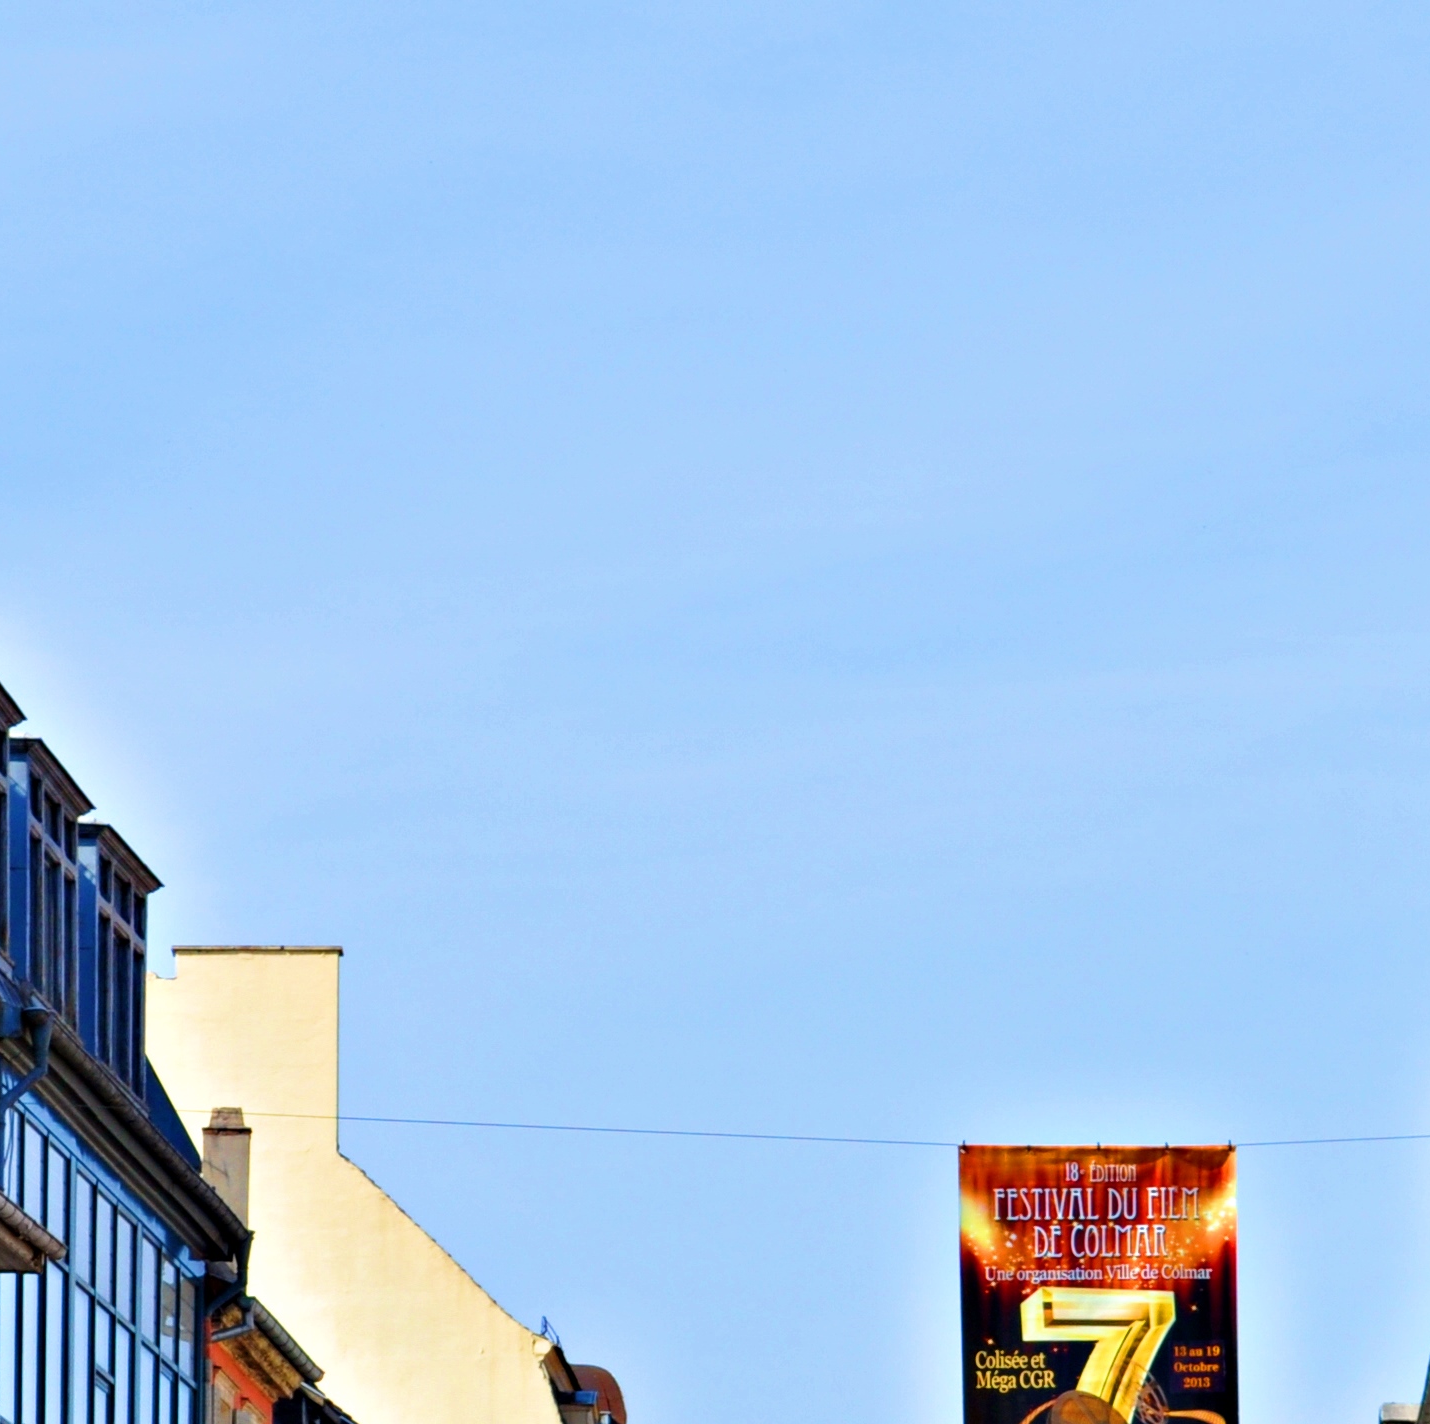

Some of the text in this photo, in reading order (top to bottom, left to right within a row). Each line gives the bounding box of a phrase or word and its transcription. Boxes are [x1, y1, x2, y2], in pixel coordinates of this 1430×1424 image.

[1089, 1161, 1137, 1182] ÉDITION
[993, 1186, 1200, 1221] FESTIVAL DU FILM
[1033, 1224, 1169, 1258] DE COLMAR
[984, 1265, 1212, 1284] Une organisation Ville de Colmar
[975, 1350, 1046, 1370] Colisée et
[1173, 1361, 1219, 1373] Octobre
[975, 1370, 1056, 1393] Méga CGR
[1183, 1377, 1211, 1388] 2013
